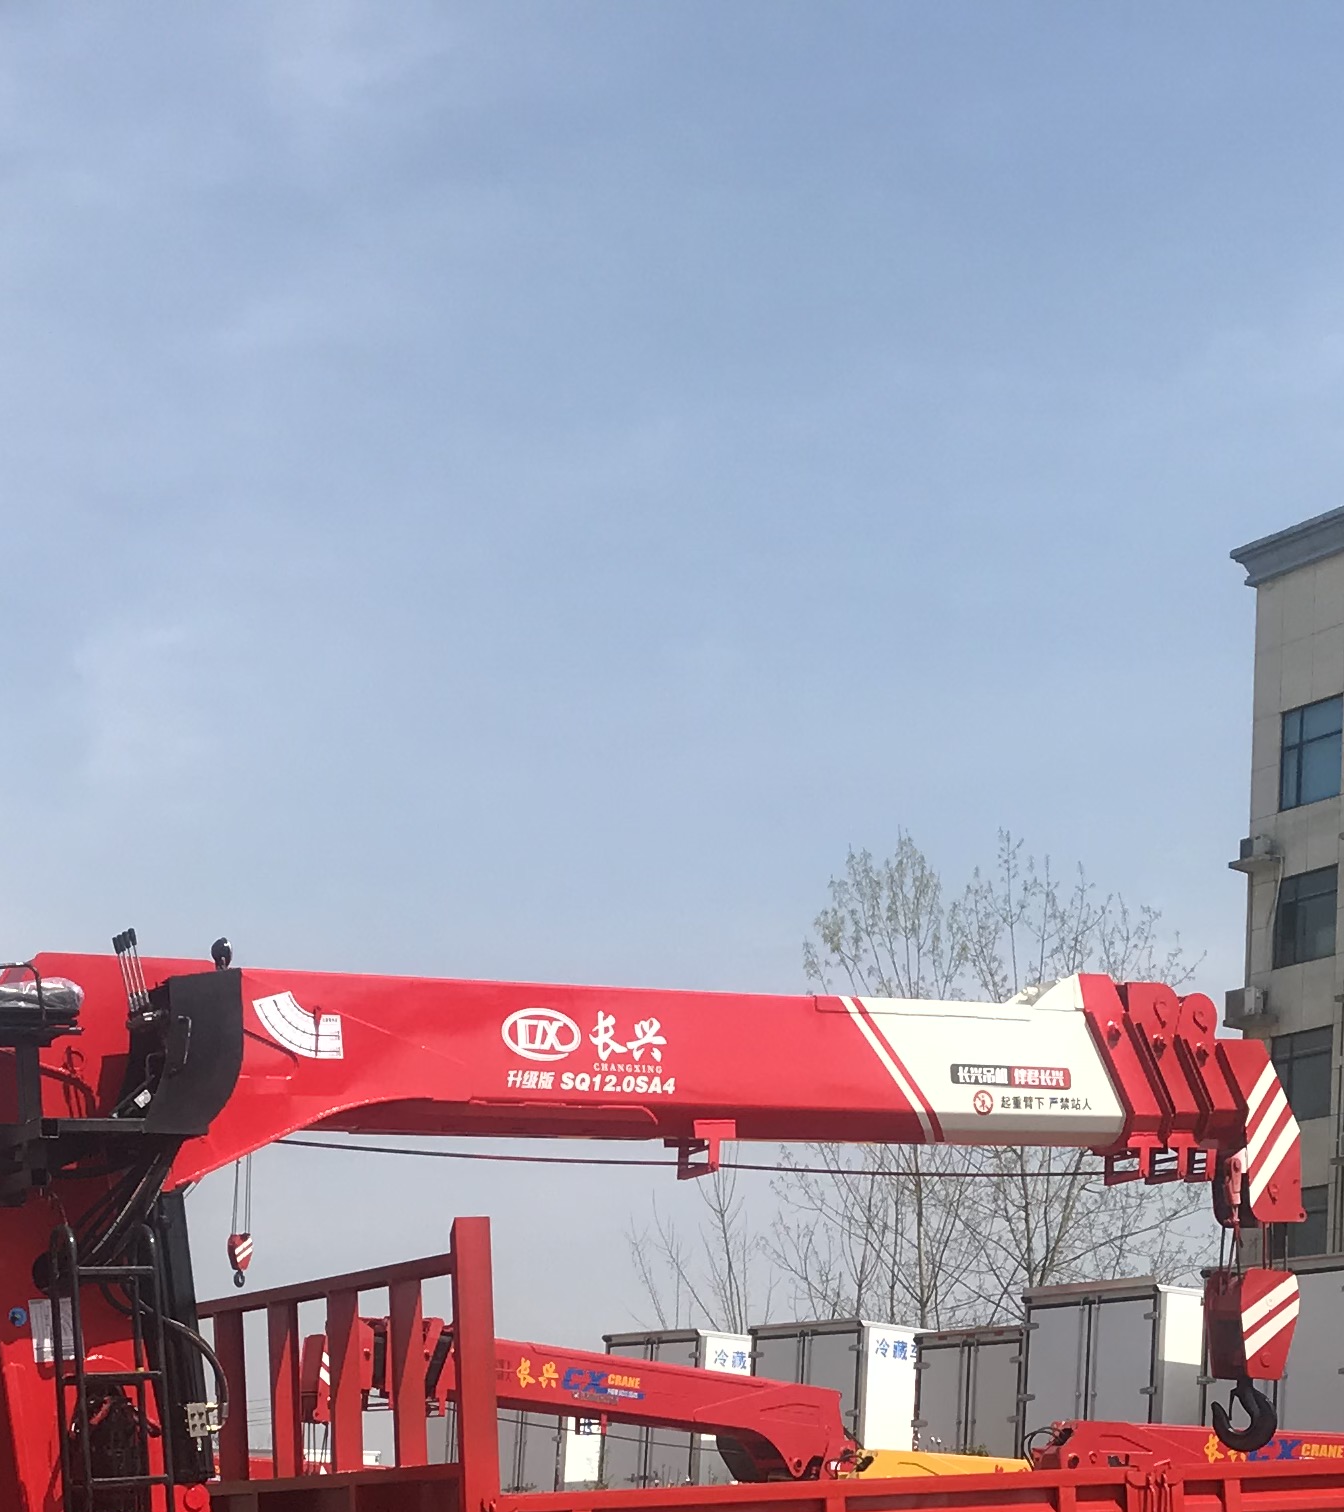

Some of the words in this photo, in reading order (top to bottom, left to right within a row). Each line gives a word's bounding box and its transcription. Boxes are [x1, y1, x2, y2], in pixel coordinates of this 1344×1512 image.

[589, 1010, 668, 1062] 长兴
[593, 1062, 663, 1075] CHANGXING
[507, 1070, 556, 1090] 升级版
[560, 1072, 676, 1095] SQ12.0SA4
[1000, 1096, 1045, 1110] 起重臂下
[1049, 1097, 1092, 1111] 严禁站人
[607, 1373, 641, 1389] CRANE
[1300, 1443, 1344, 1458] CRANE
